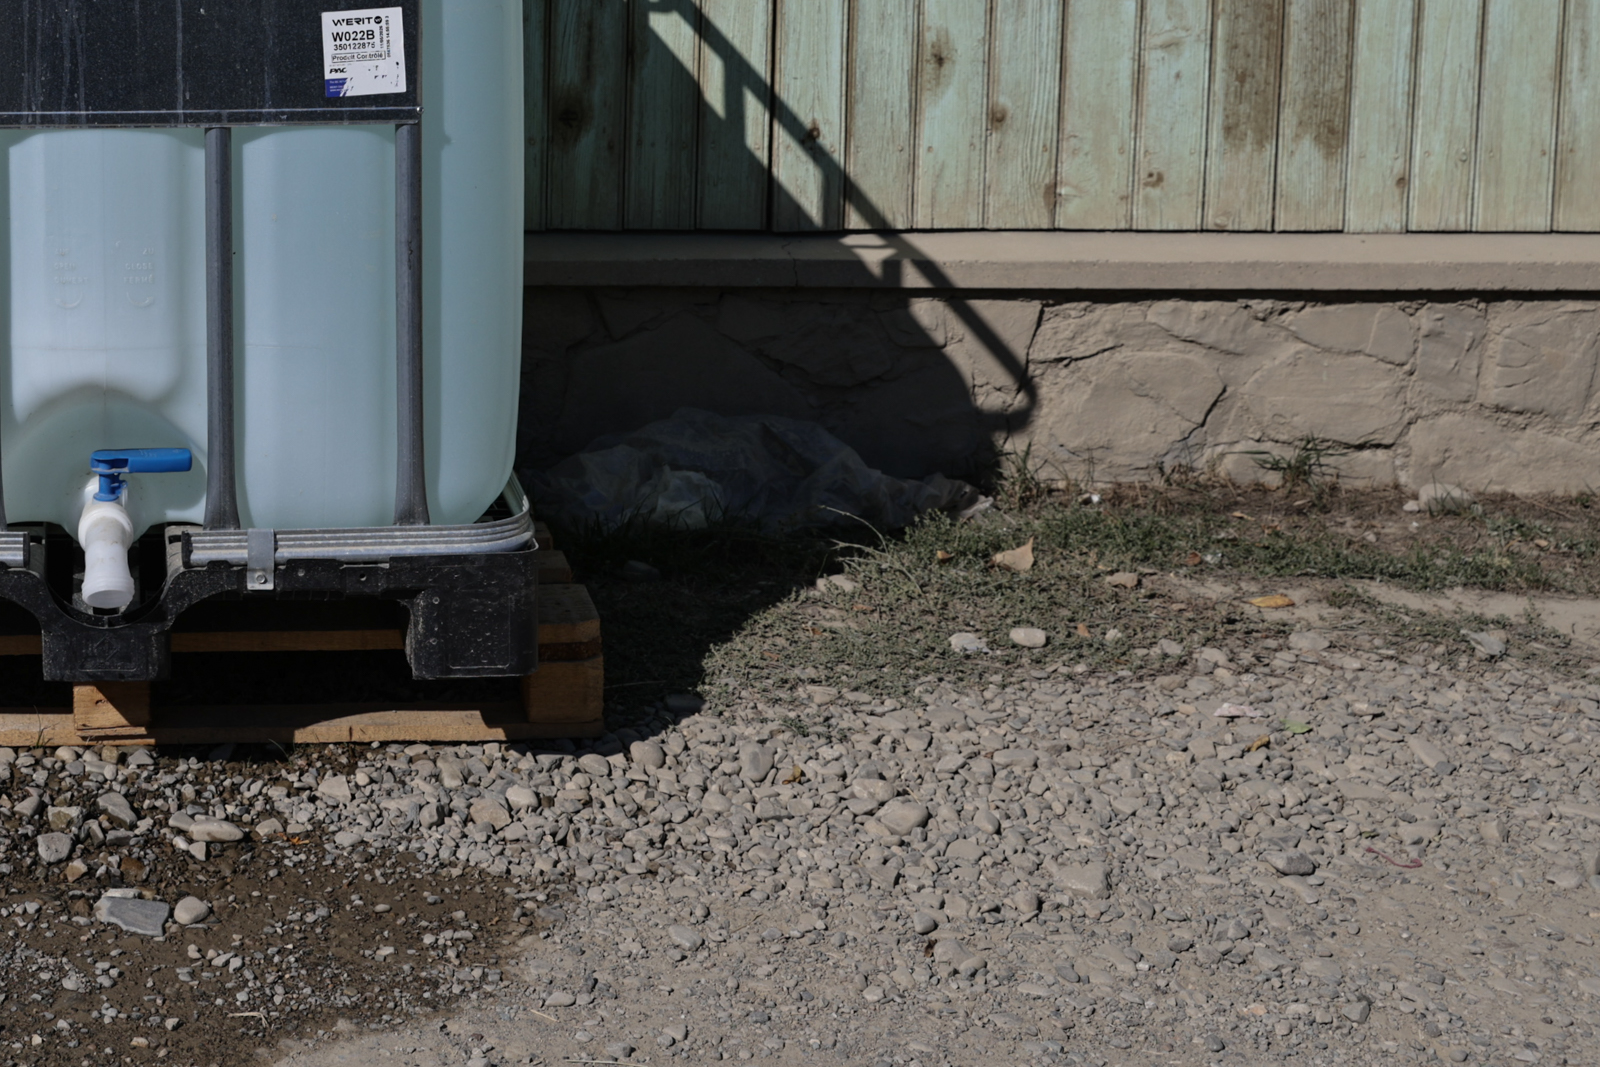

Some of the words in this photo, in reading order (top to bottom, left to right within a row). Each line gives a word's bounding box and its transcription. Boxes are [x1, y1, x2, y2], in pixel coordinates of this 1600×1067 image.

[332, 16, 373, 26] WERIT
[332, 30, 375, 42] W022B
[125, 262, 154, 271] CLOSE
[53, 276, 89, 285] OUVERT
[123, 273, 154, 285] FERMÉ
